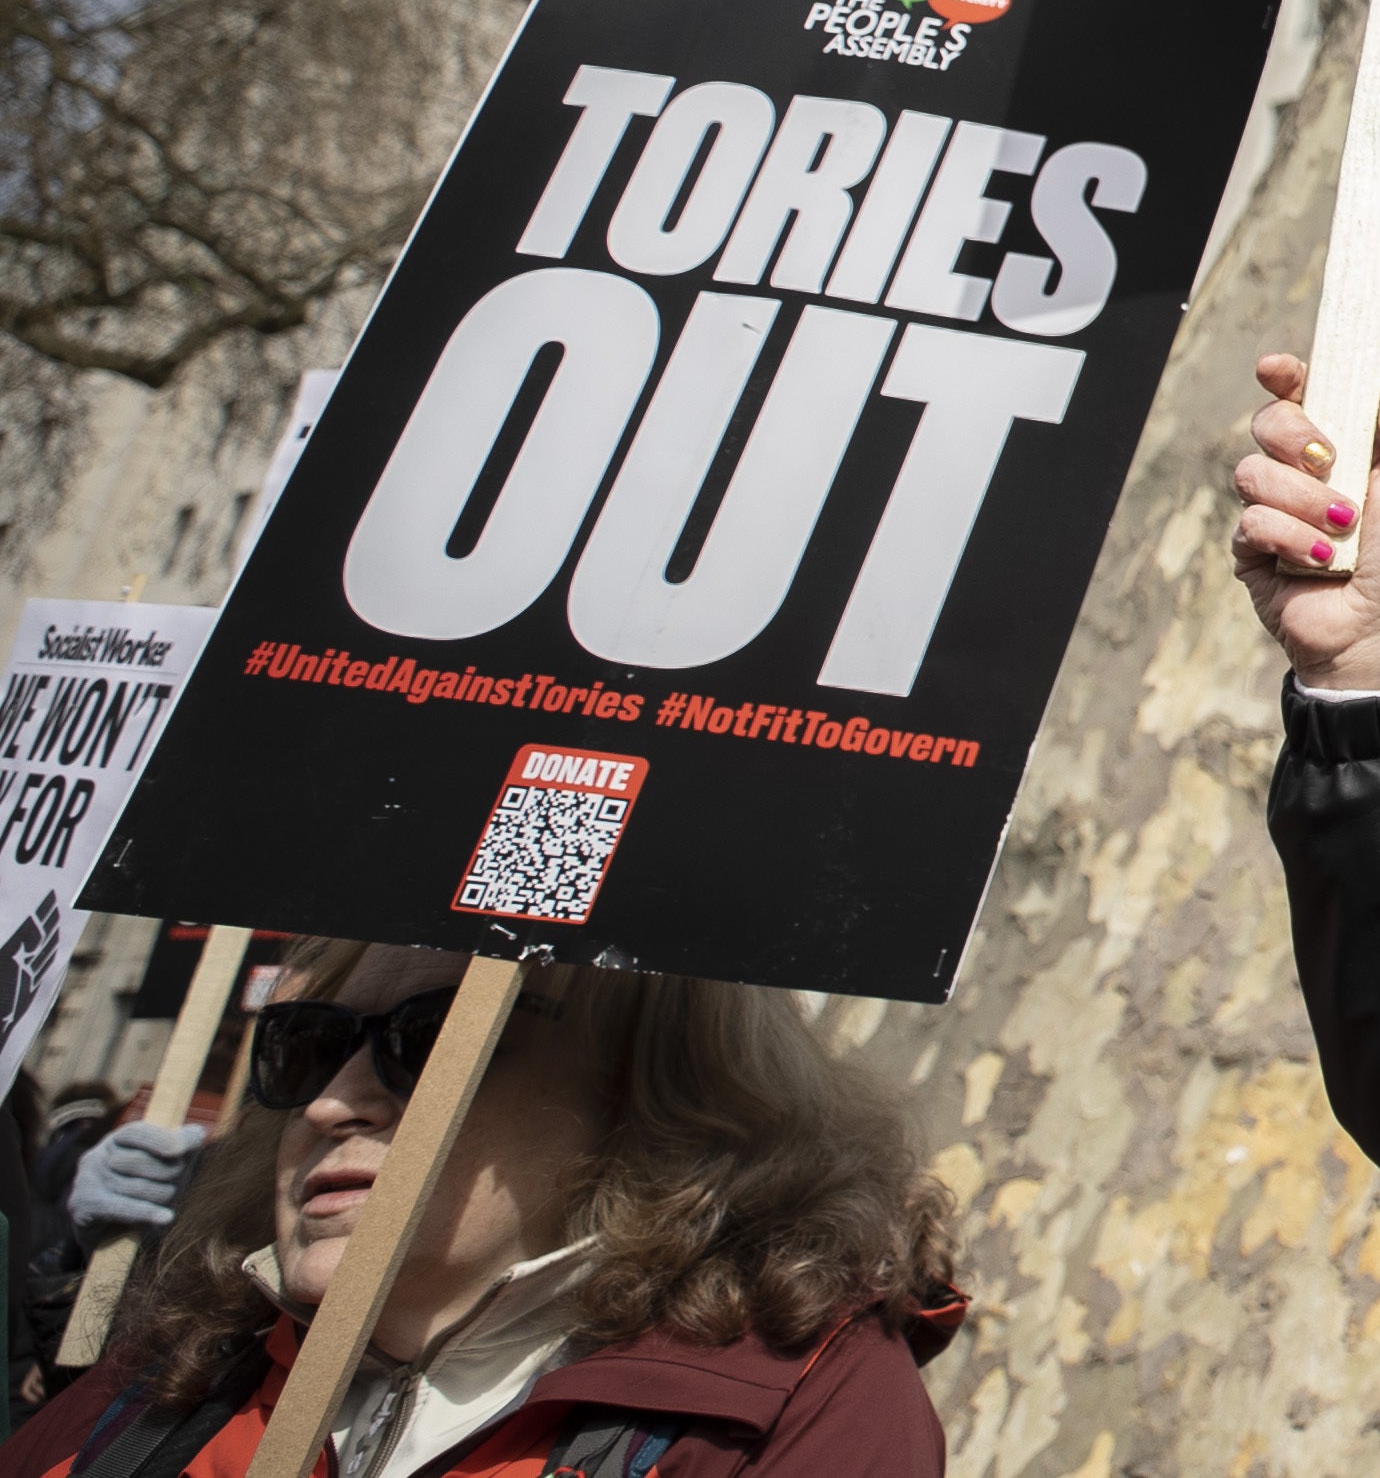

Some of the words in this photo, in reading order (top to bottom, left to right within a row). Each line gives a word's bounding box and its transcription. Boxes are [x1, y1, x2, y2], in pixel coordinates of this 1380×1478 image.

[823, 33, 961, 71] ASSEMBLY
[516, 64, 1148, 336] TORIES
[343, 267, 1086, 698] OUT
[27, 675, 174, 771] WON'T
[243, 640, 645, 722] #UnitedAgainstTories
[655, 692, 981, 768] #NotFitToGovern
[521, 751, 636, 791] DONATE
[0, 772, 95, 868] FOR
